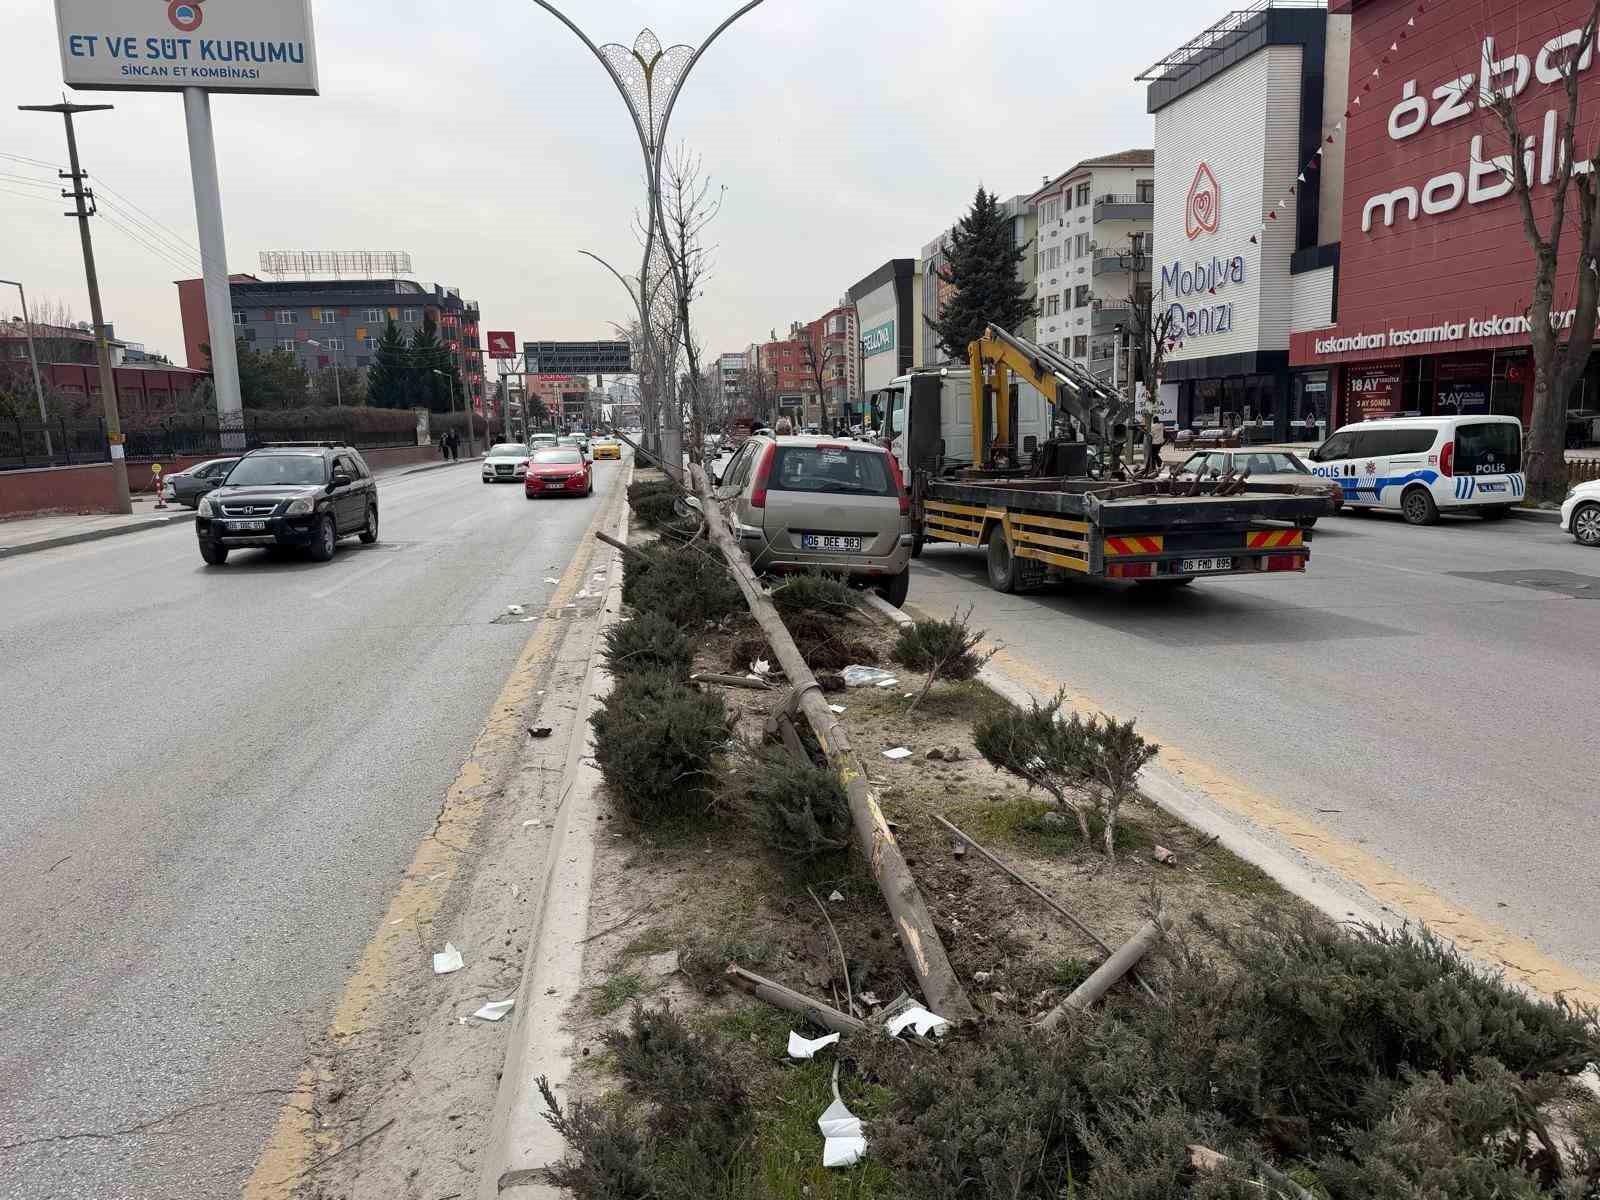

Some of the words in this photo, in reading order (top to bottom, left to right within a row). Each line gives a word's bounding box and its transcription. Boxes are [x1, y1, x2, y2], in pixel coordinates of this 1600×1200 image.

[69, 35, 98, 57] ET
[105, 36, 138, 58] VE
[146, 38, 191, 60] SÜT
[200, 39, 304, 64] KURUMU
[121, 64, 168, 77] SİNCAN
[173, 66, 188, 77] ET
[191, 66, 260, 79] KOMBİNASI
[1161, 255, 1244, 301] Mobilya
[1314, 332, 1386, 354] kıskandıran
[1389, 320, 1467, 346] tasarımlar
[1351, 379, 1363, 391] 18
[1363, 378, 1379, 391] AY
[808, 535, 818, 546] 06
[844, 537, 860, 548] 983
[1184, 560, 1193, 570] 06
